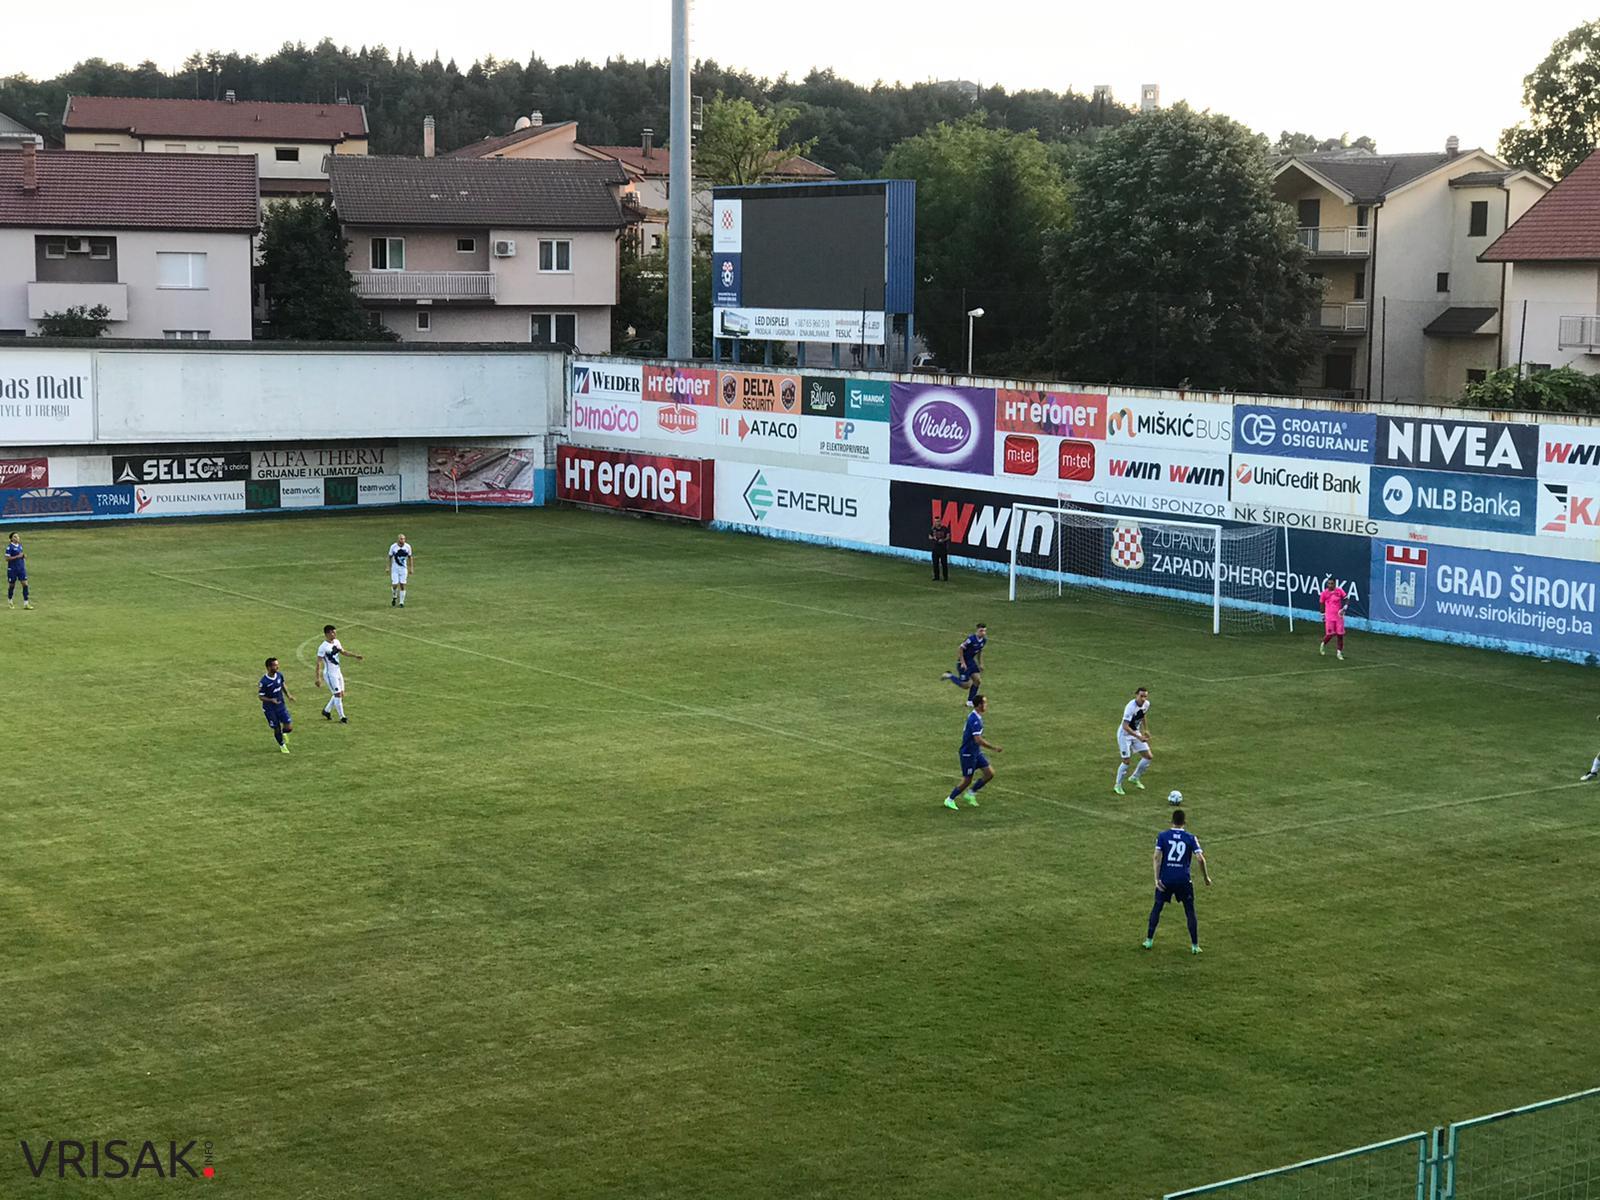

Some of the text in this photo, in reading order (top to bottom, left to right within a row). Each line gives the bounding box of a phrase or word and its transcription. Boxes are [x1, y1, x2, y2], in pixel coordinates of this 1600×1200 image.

[592, 371, 641, 393] WEIDER
[743, 378, 775, 397] DELTA
[0, 404, 21, 417] TYLE
[742, 397, 775, 412] SECURITY
[750, 420, 798, 439] ATACO
[919, 412, 966, 440] Violeta
[1282, 418, 1342, 435] CROATIA
[1281, 434, 1369, 453] OSIGURANJE
[1388, 419, 1523, 470] NIVEA
[229, 463, 249, 471] choice
[257, 448, 385, 468] ALFA THERM
[143, 457, 225, 480] SELECT
[257, 468, 306, 479] GRIJANJE
[314, 466, 384, 477] KLIMATIZACIJA
[359, 483, 397, 493] teamwork
[1254, 466, 1361, 494] UniCredit Bank
[97, 493, 130, 507] TRPANJ
[156, 492, 244, 503] POLIKLINIKA VITALIS
[282, 486, 321, 495] teamwork
[777, 488, 858, 517] EMERUS
[1417, 486, 1521, 517] NLB Banka
[1093, 490, 1379, 535] GLAVNI SPONZOR NK ŠIROKI BRIJEG
[1436, 564, 1596, 612] GRAD ŠIROKI
[1436, 600, 1593, 636] www.sirokibrijeg.ba
[1167, 839, 1187, 862] 29
